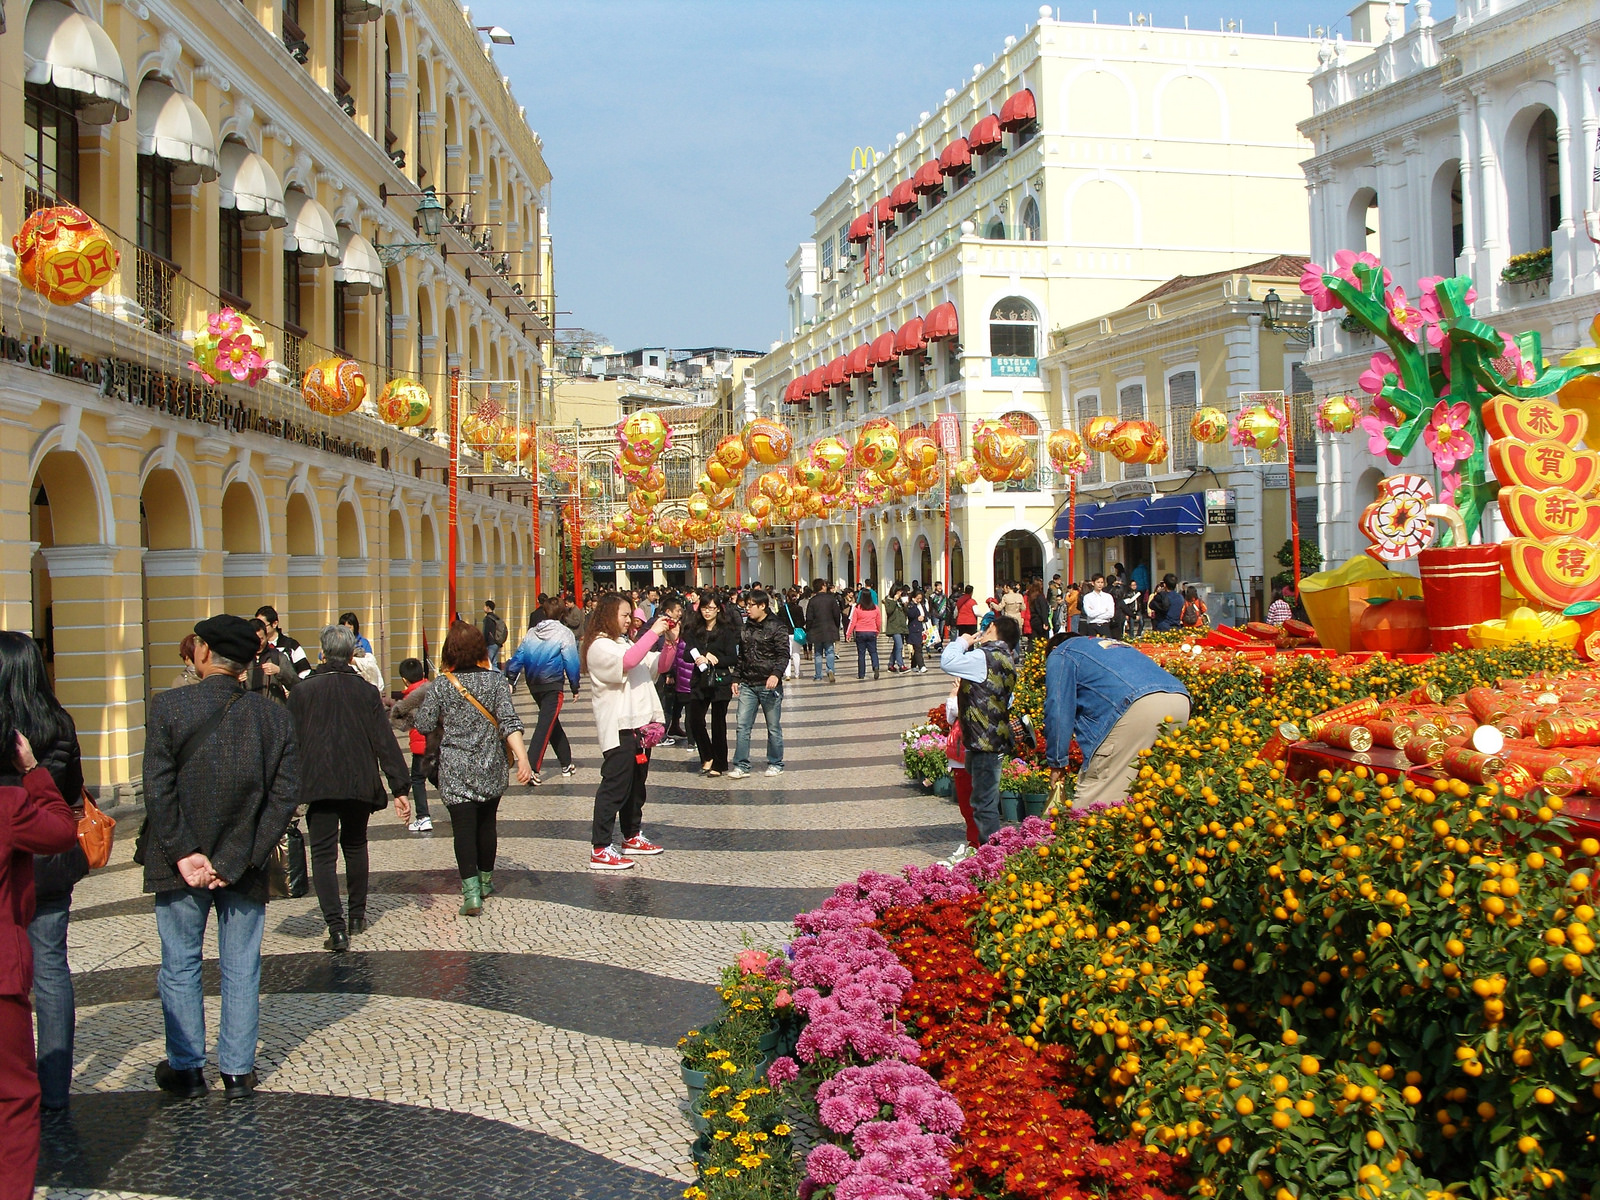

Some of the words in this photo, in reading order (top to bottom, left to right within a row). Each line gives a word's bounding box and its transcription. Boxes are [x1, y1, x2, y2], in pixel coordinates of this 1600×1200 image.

[28, 335, 51, 372] de
[997, 358, 1031, 366] ESTELA
[1526, 405, 1591, 578] 恭賀新禧
